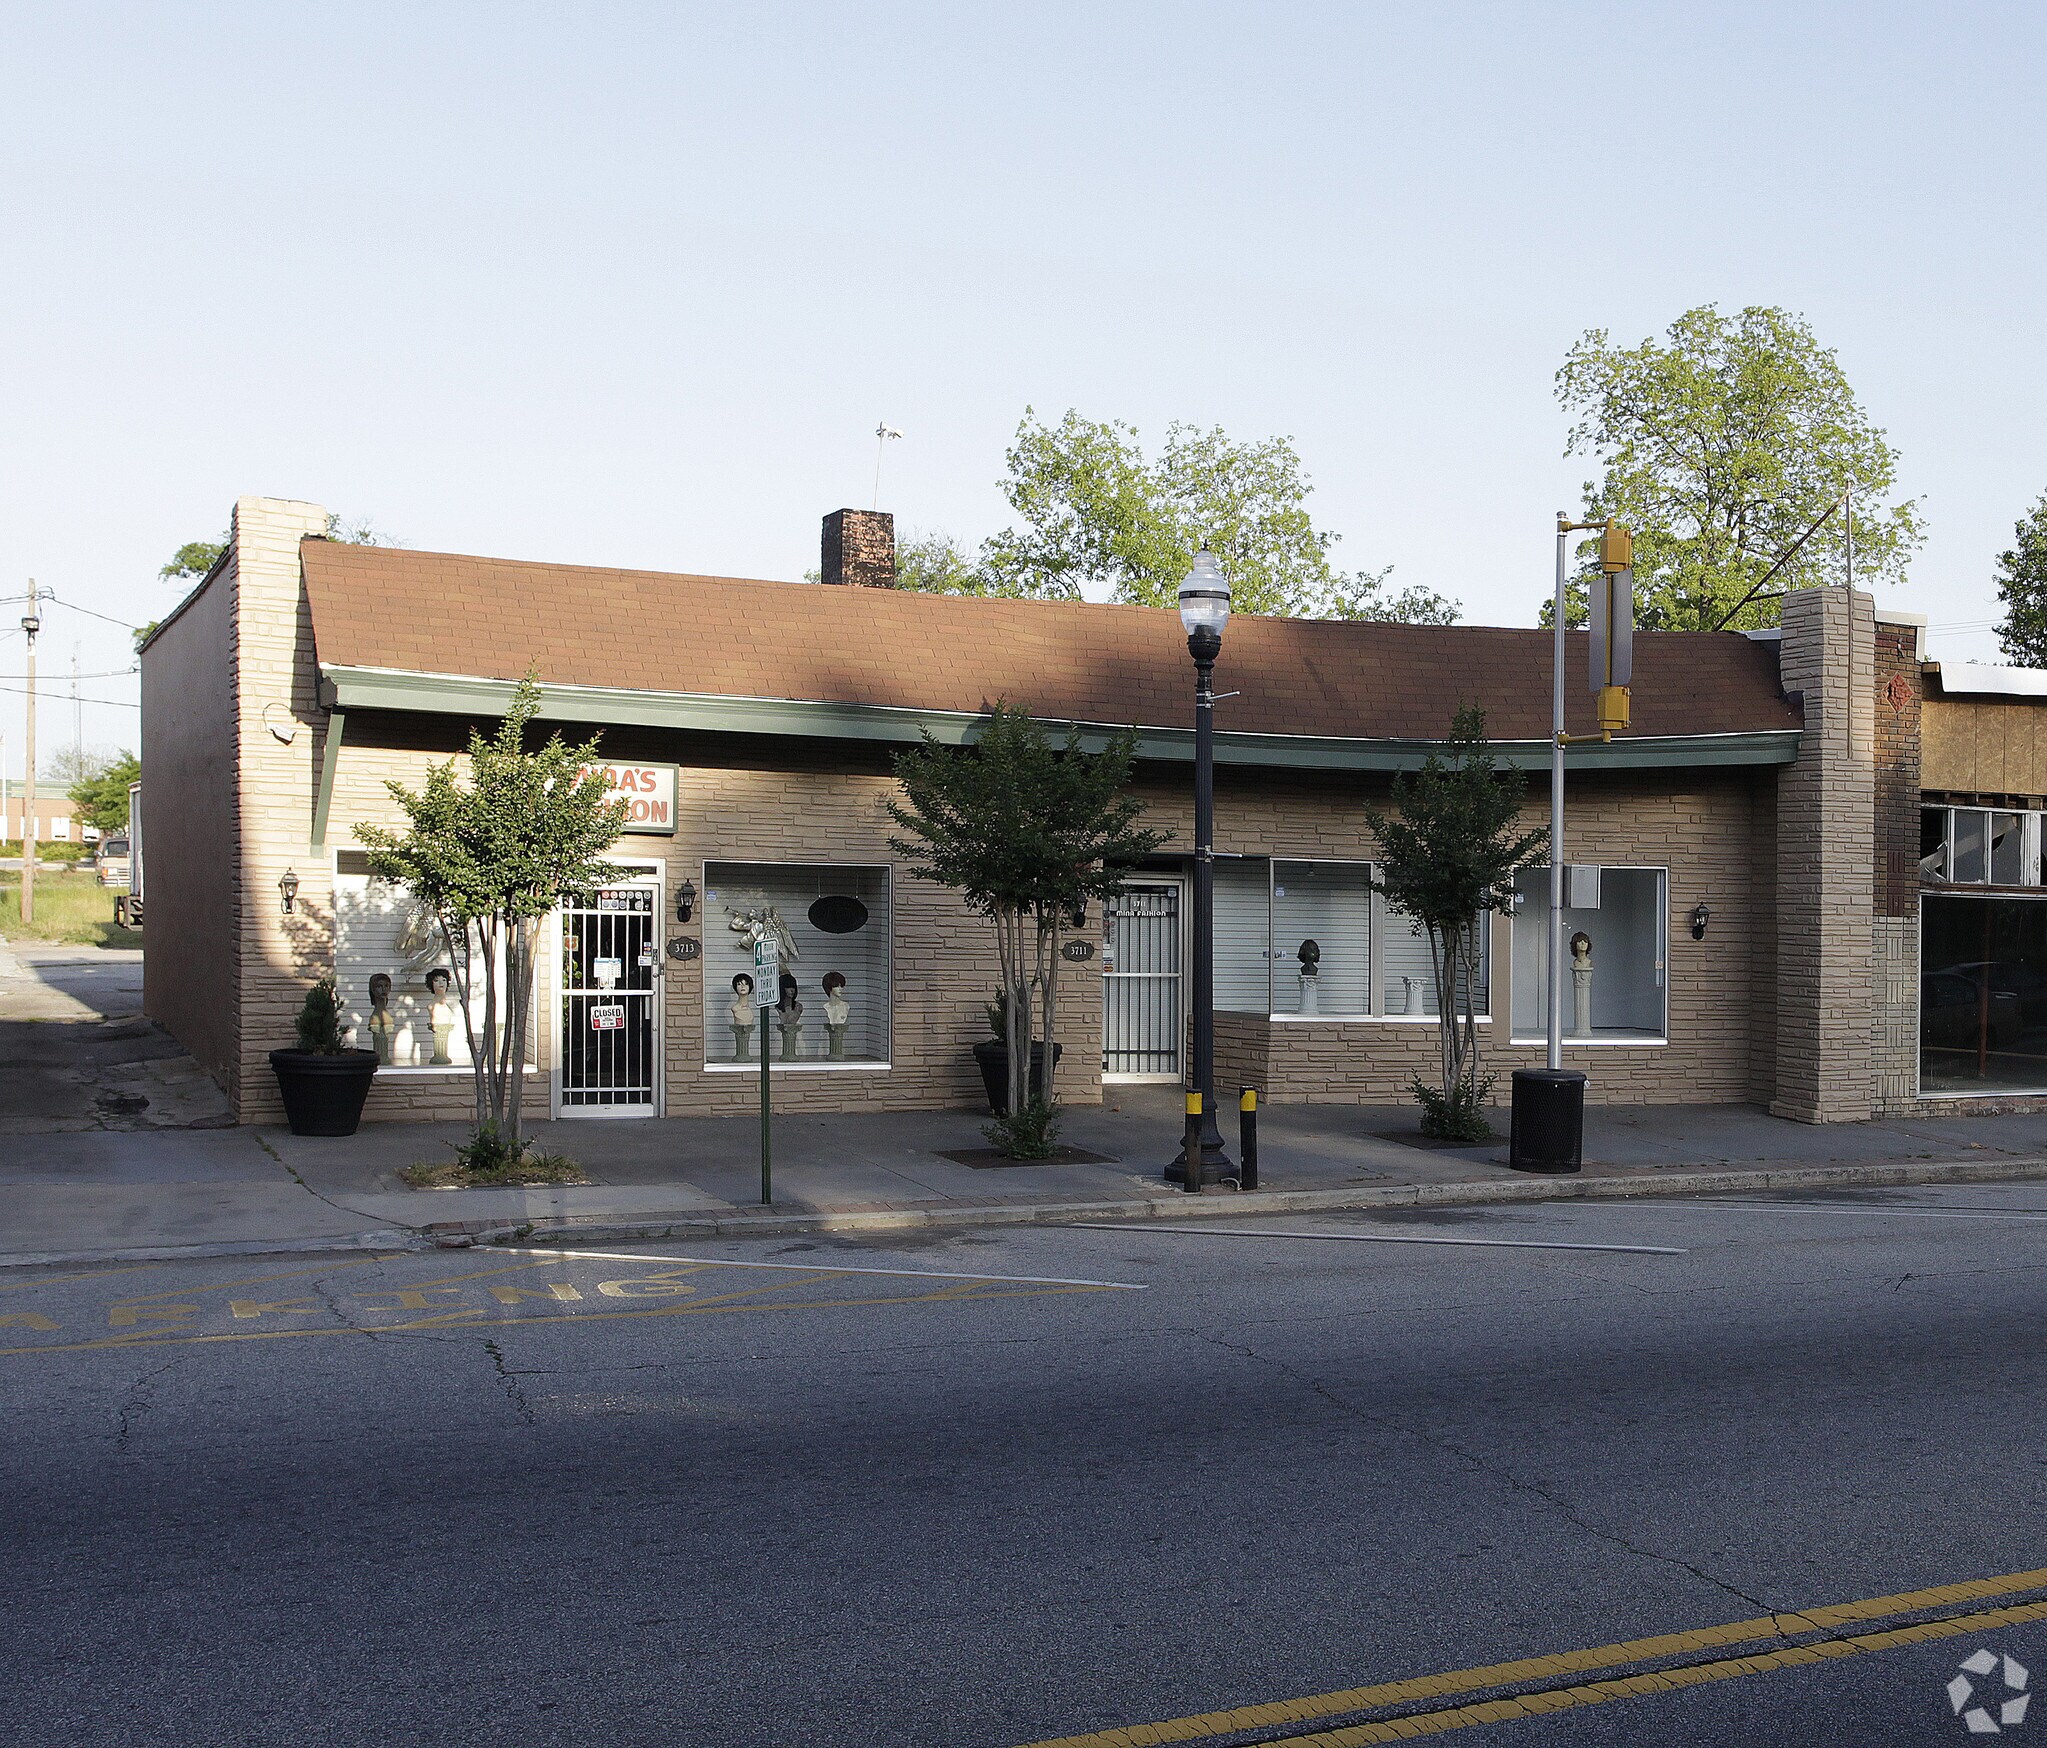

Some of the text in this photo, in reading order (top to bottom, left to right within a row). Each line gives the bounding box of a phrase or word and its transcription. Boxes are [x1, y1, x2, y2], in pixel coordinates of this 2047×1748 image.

[675, 943, 695, 953] 3713
[756, 945, 761, 962] 4
[1071, 946, 1087, 955] 3711
[757, 966, 776, 977] MONDAY
[761, 978, 772, 989] THRU
[758, 990, 776, 1002] FRIDAY
[594, 1008, 621, 1019] CLOSED
